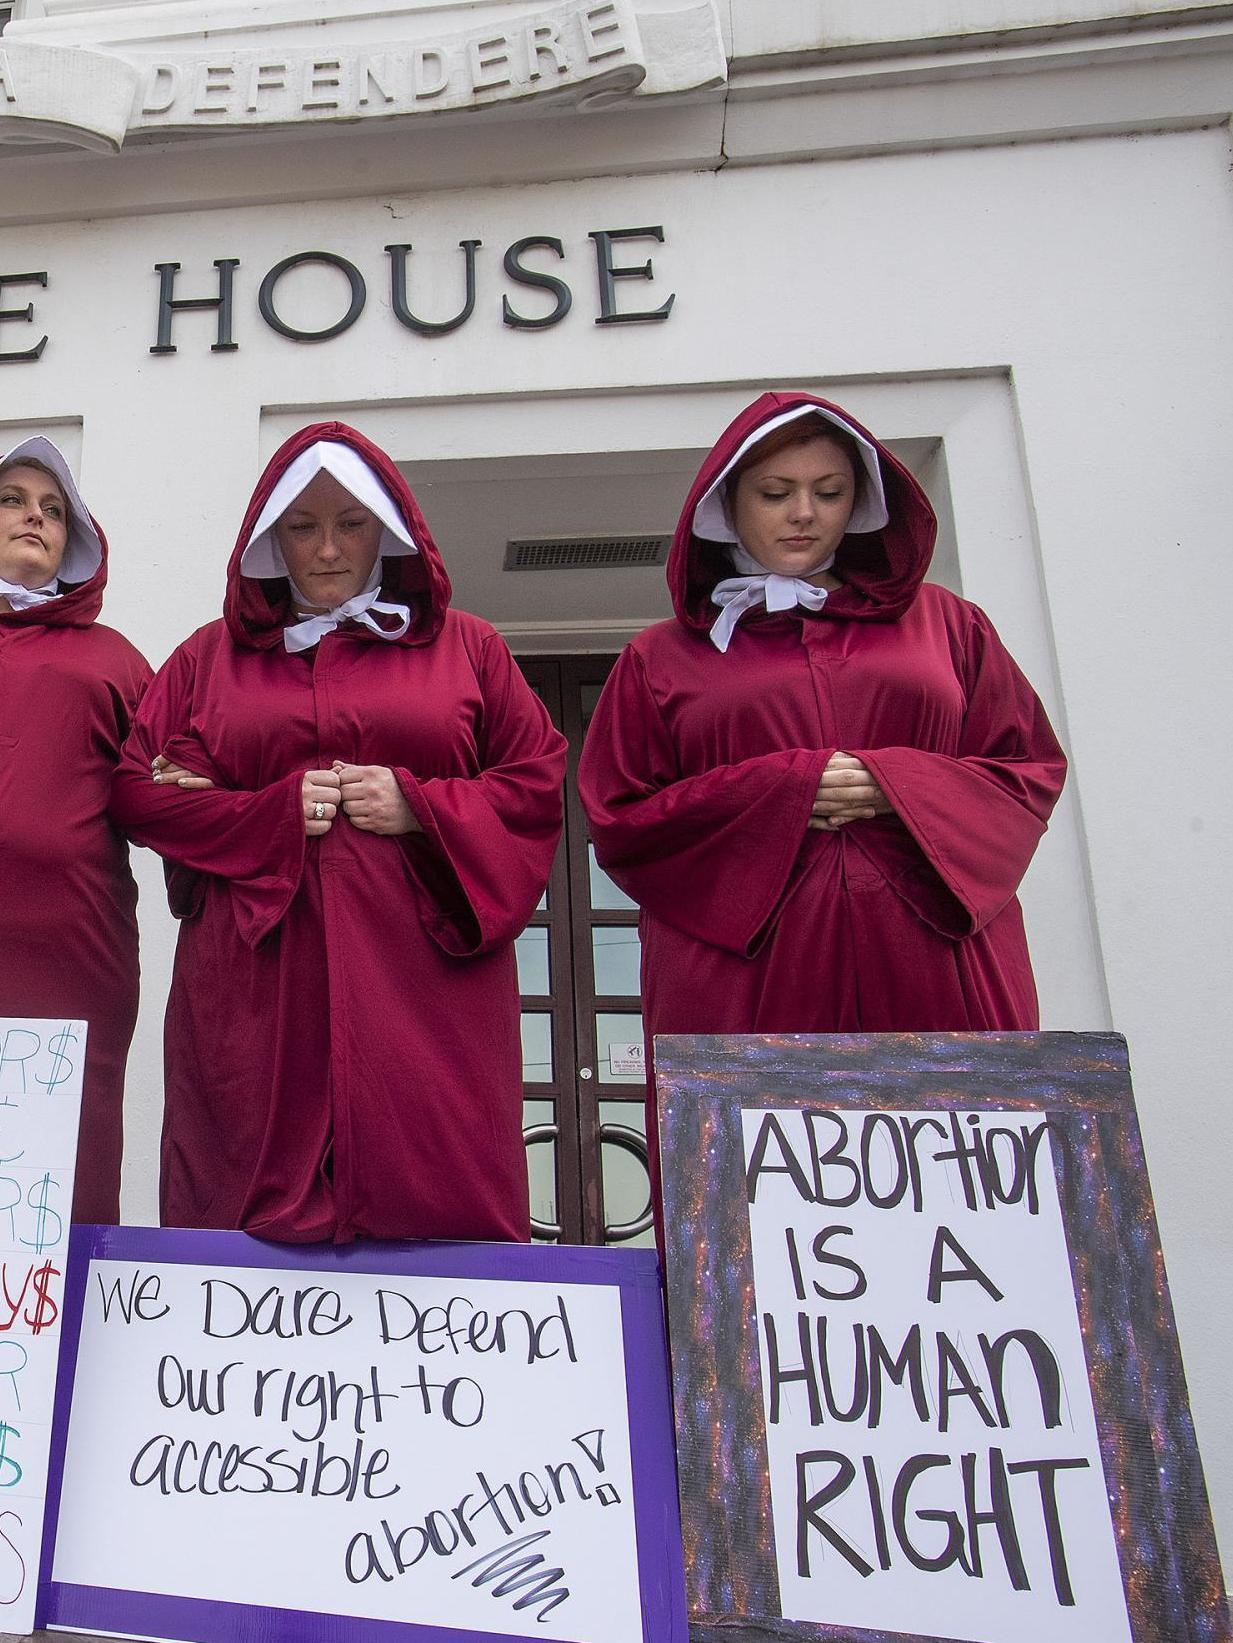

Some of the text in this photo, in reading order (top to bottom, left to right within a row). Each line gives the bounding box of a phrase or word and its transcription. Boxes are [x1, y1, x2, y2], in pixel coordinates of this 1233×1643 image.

[140, 3, 627, 116] DEFENDERE
[148, 225, 676, 355] HOUSE
[785, 1225, 1005, 1304] IS A
[201, 1279, 354, 1340] Dare
[376, 1289, 580, 1364] Defend
[255, 1364, 400, 1442] right
[401, 1364, 486, 1428] to
[129, 1433, 401, 1502] accessible
[795, 1447, 1091, 1607] RIGHT
